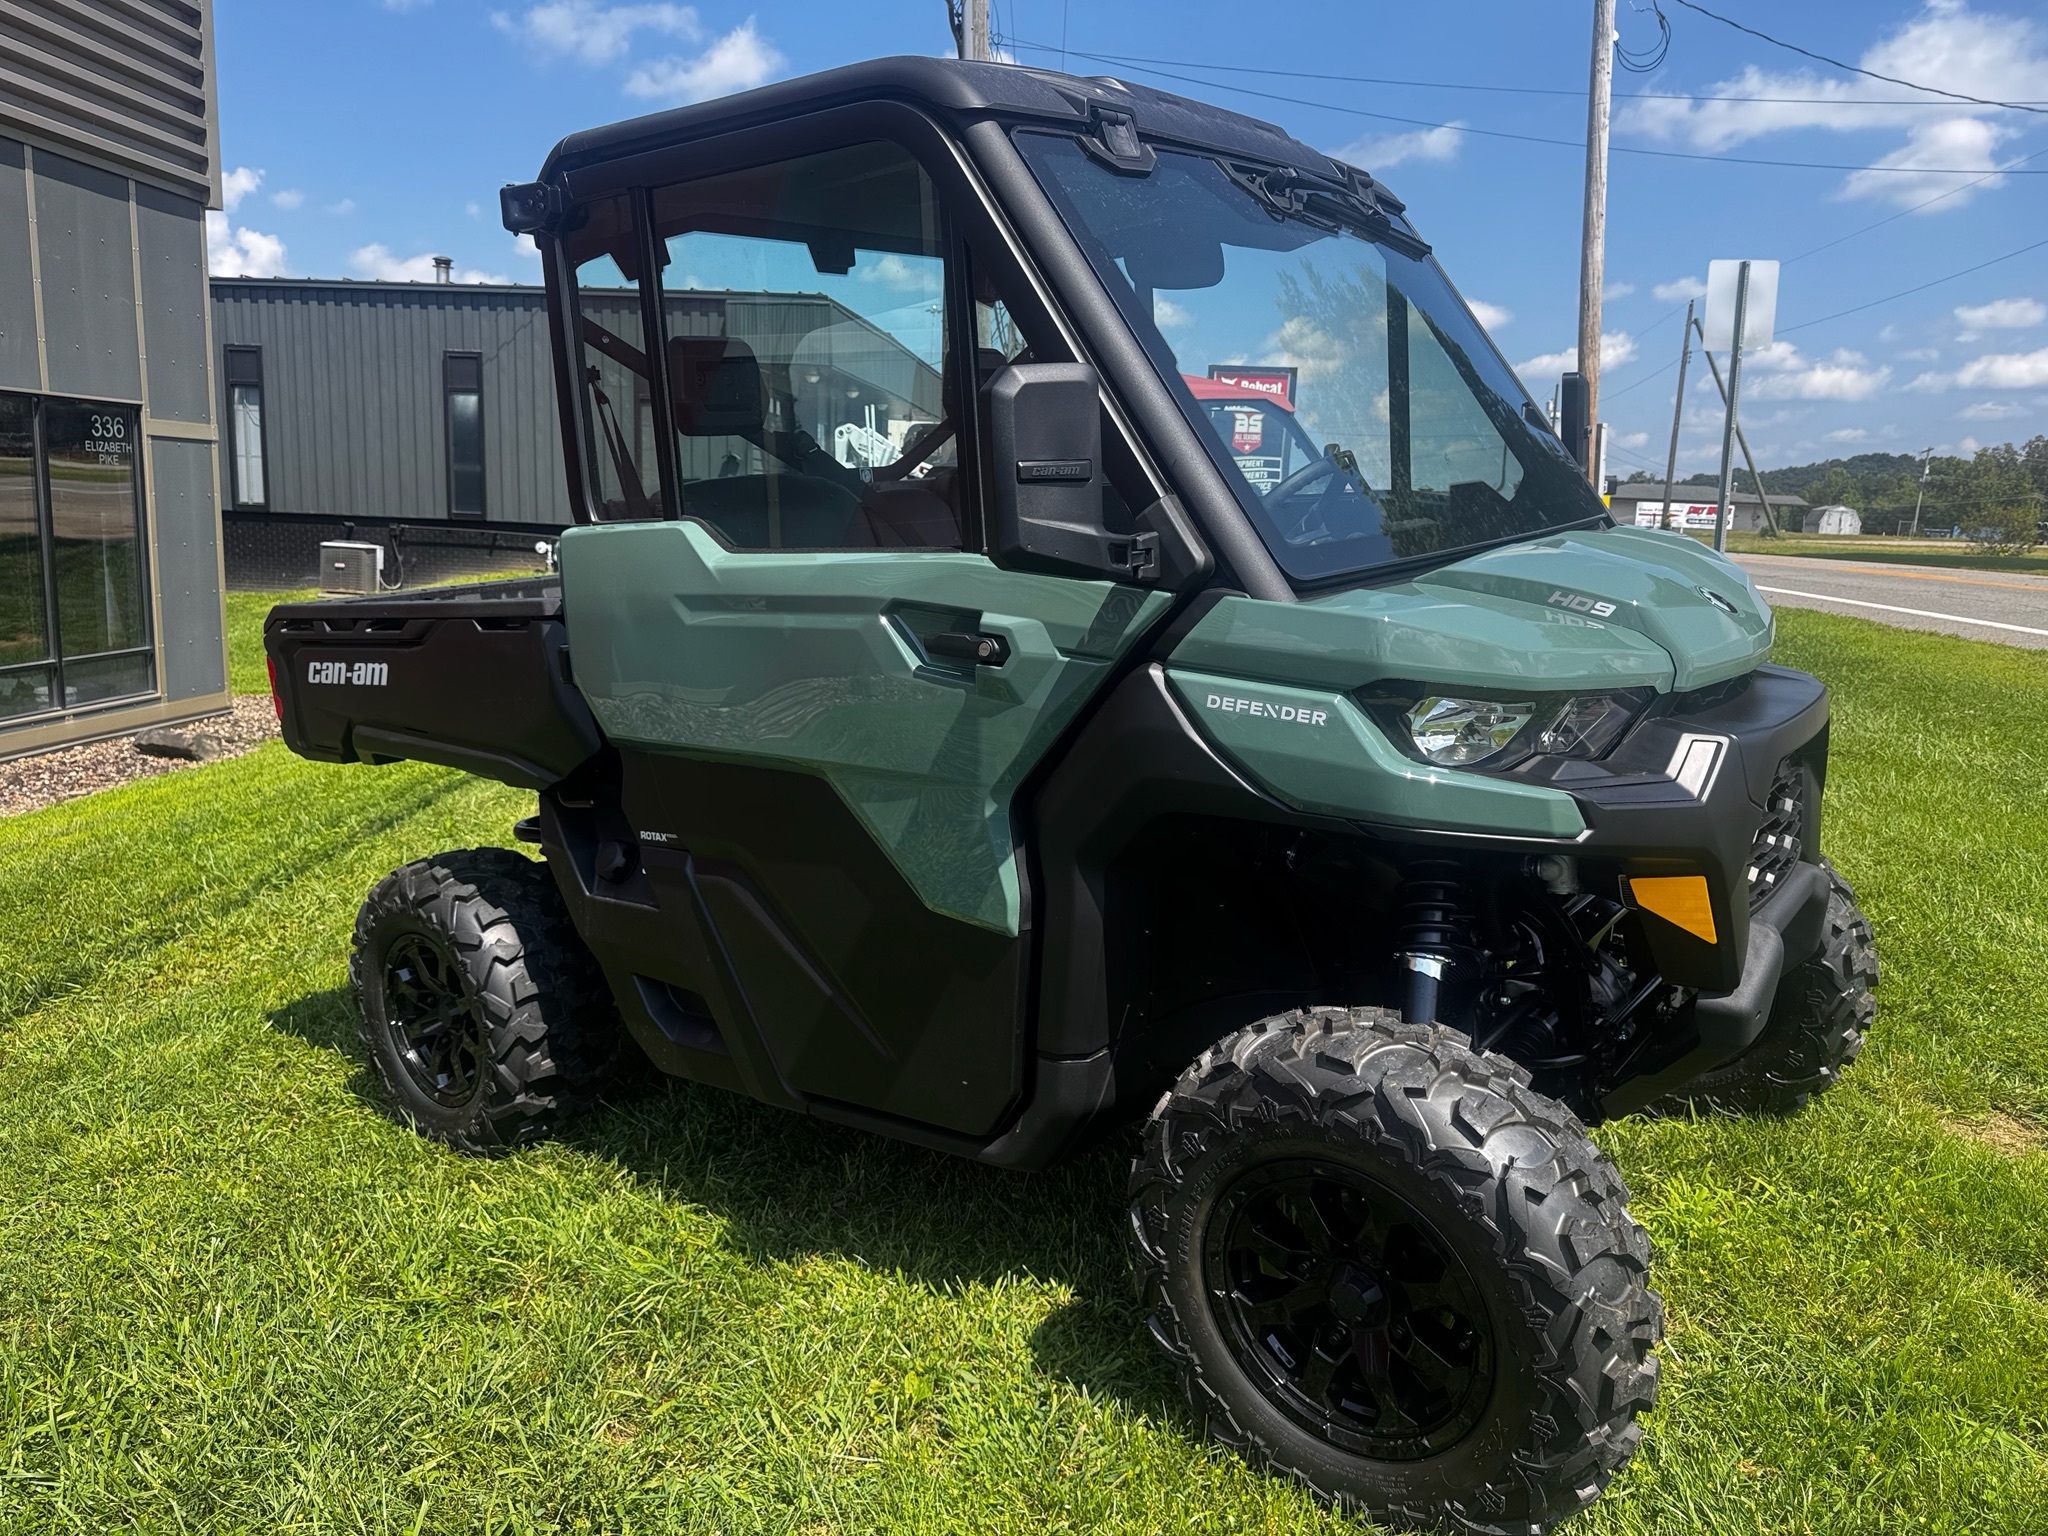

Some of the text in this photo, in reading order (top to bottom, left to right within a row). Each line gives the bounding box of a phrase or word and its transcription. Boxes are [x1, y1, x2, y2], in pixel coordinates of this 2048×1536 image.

[91, 415, 125, 438] 336
[85, 440, 132, 453] ELIZABETH
[99, 454, 119, 465] PIKE
[1032, 466, 1080, 476] can-am
[1547, 591, 1617, 617] HD9
[308, 662, 388, 686] can-am
[1206, 694, 1327, 726] DEFENDER
[640, 830, 667, 842] ROTAX
